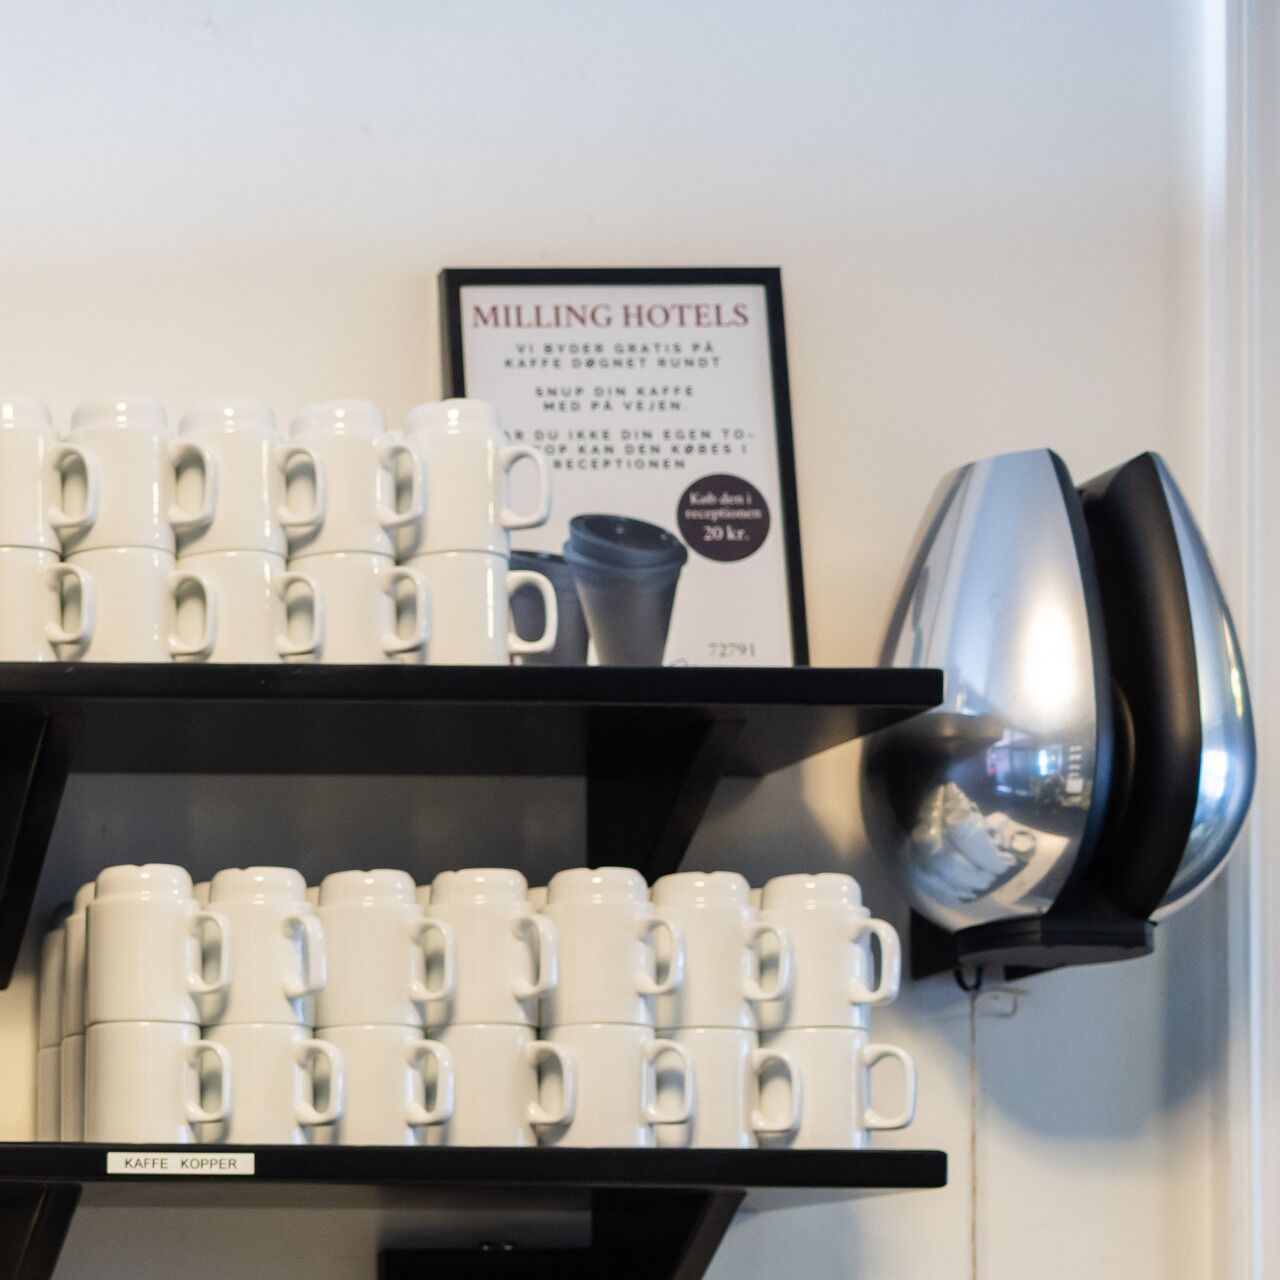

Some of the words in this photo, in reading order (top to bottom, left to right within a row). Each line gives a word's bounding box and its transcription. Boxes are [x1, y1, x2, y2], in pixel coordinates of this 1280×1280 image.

[472, 304, 613, 329] MILLING
[623, 303, 750, 329] HOTELS
[515, 343, 534, 354] VI
[543, 342, 604, 354] BYDER
[614, 343, 682, 354] GRATIS
[692, 340, 715, 354] PÅ
[504, 358, 561, 369] KAFFE
[572, 357, 647, 369] DØGNET
[657, 357, 721, 369] RUNDT
[536, 386, 585, 397] SNUP
[594, 386, 627, 397] DIN
[637, 386, 694, 397] KAFFE
[543, 401, 581, 411] MED
[591, 398, 613, 411] PÅ
[534, 430, 558, 440] DU
[568, 430, 610, 440] IKKE
[621, 430, 653, 440] DIN
[663, 430, 711, 440] EGEN
[578, 444, 614, 454] KAN
[625, 444, 661, 454] DEN
[671, 444, 732, 455] KØBES
[553, 459, 686, 469] RECEPTIONEN
[703, 525, 724, 541] 20
[726, 525, 750, 541] kr.
[124, 1158, 169, 1170] KAFFE
[180, 1158, 238, 1170] KOPPER
